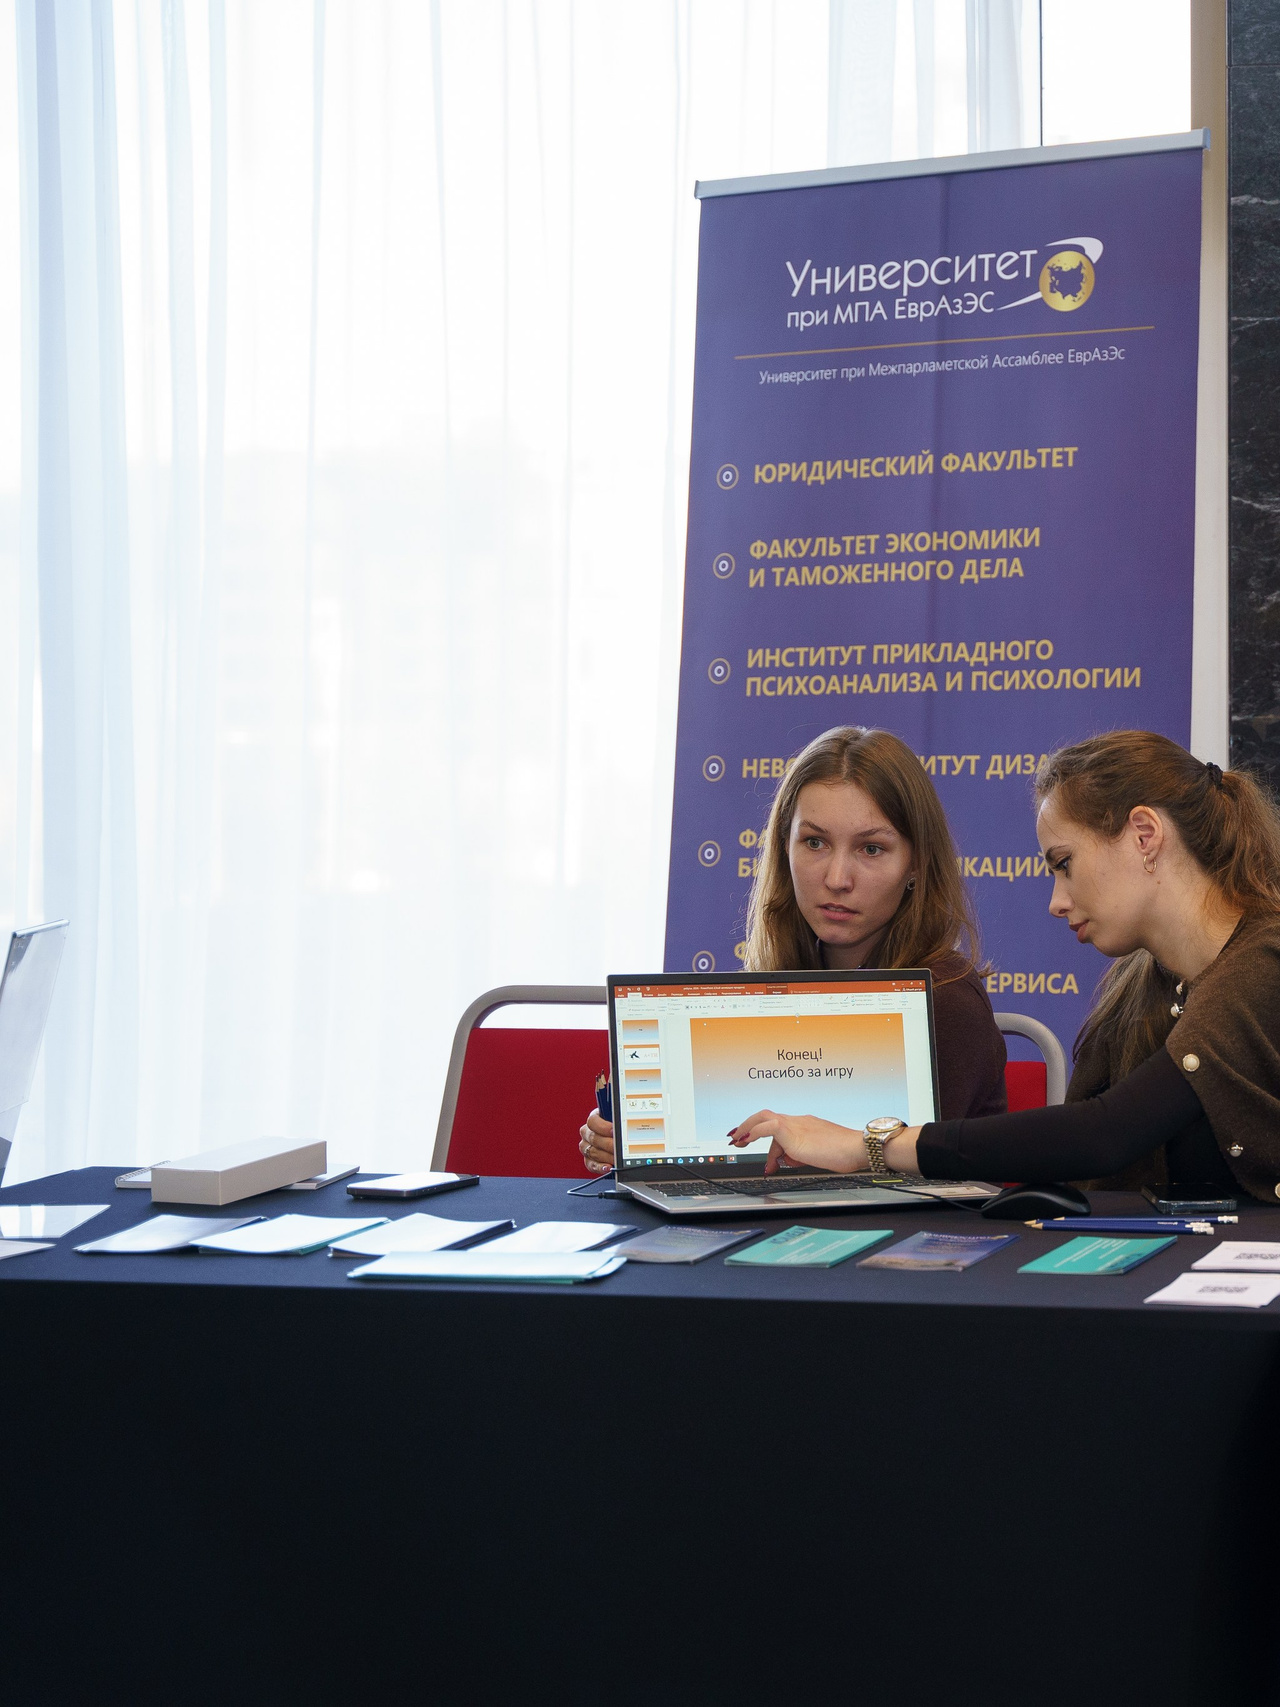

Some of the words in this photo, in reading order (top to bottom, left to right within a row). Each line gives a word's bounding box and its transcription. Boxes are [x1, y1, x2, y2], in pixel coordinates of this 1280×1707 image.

[785, 250, 1038, 295] Университет
[787, 310, 828, 332] при
[834, 301, 887, 324] МПА
[895, 291, 994, 322] ЕврАзЭС
[759, 369, 837, 385] Университет
[841, 367, 865, 381] при
[869, 355, 988, 377] Межпарламетской
[992, 351, 1064, 368] Ассамблее
[754, 450, 934, 486] ЮРИДИЧЕСКИЙ
[941, 447, 1078, 473] ФАКУЛЬТЕТ
[750, 535, 880, 559] ФАКУЛЬТЕТ
[885, 527, 1040, 553] ЭКОНОМИКИ
[749, 568, 765, 588] И
[772, 560, 954, 586] ТАМОЖЕННОГО
[960, 558, 1024, 584] ДЕЛА
[747, 645, 866, 668] ИНСТИТУТ
[873, 640, 1053, 667] ПРИКЛАДНОГО
[746, 672, 938, 697] ПСИХОАНАЛИЗА
[946, 671, 962, 691] И
[971, 667, 1140, 691] ПСИХОЛОГИИ
[986, 973, 1079, 995] ЕРВИСА
[776, 1048, 823, 1062] Конец!
[748, 1065, 804, 1080] Спасибо
[807, 1068, 821, 1078] за
[824, 1067, 854, 1080] игру
